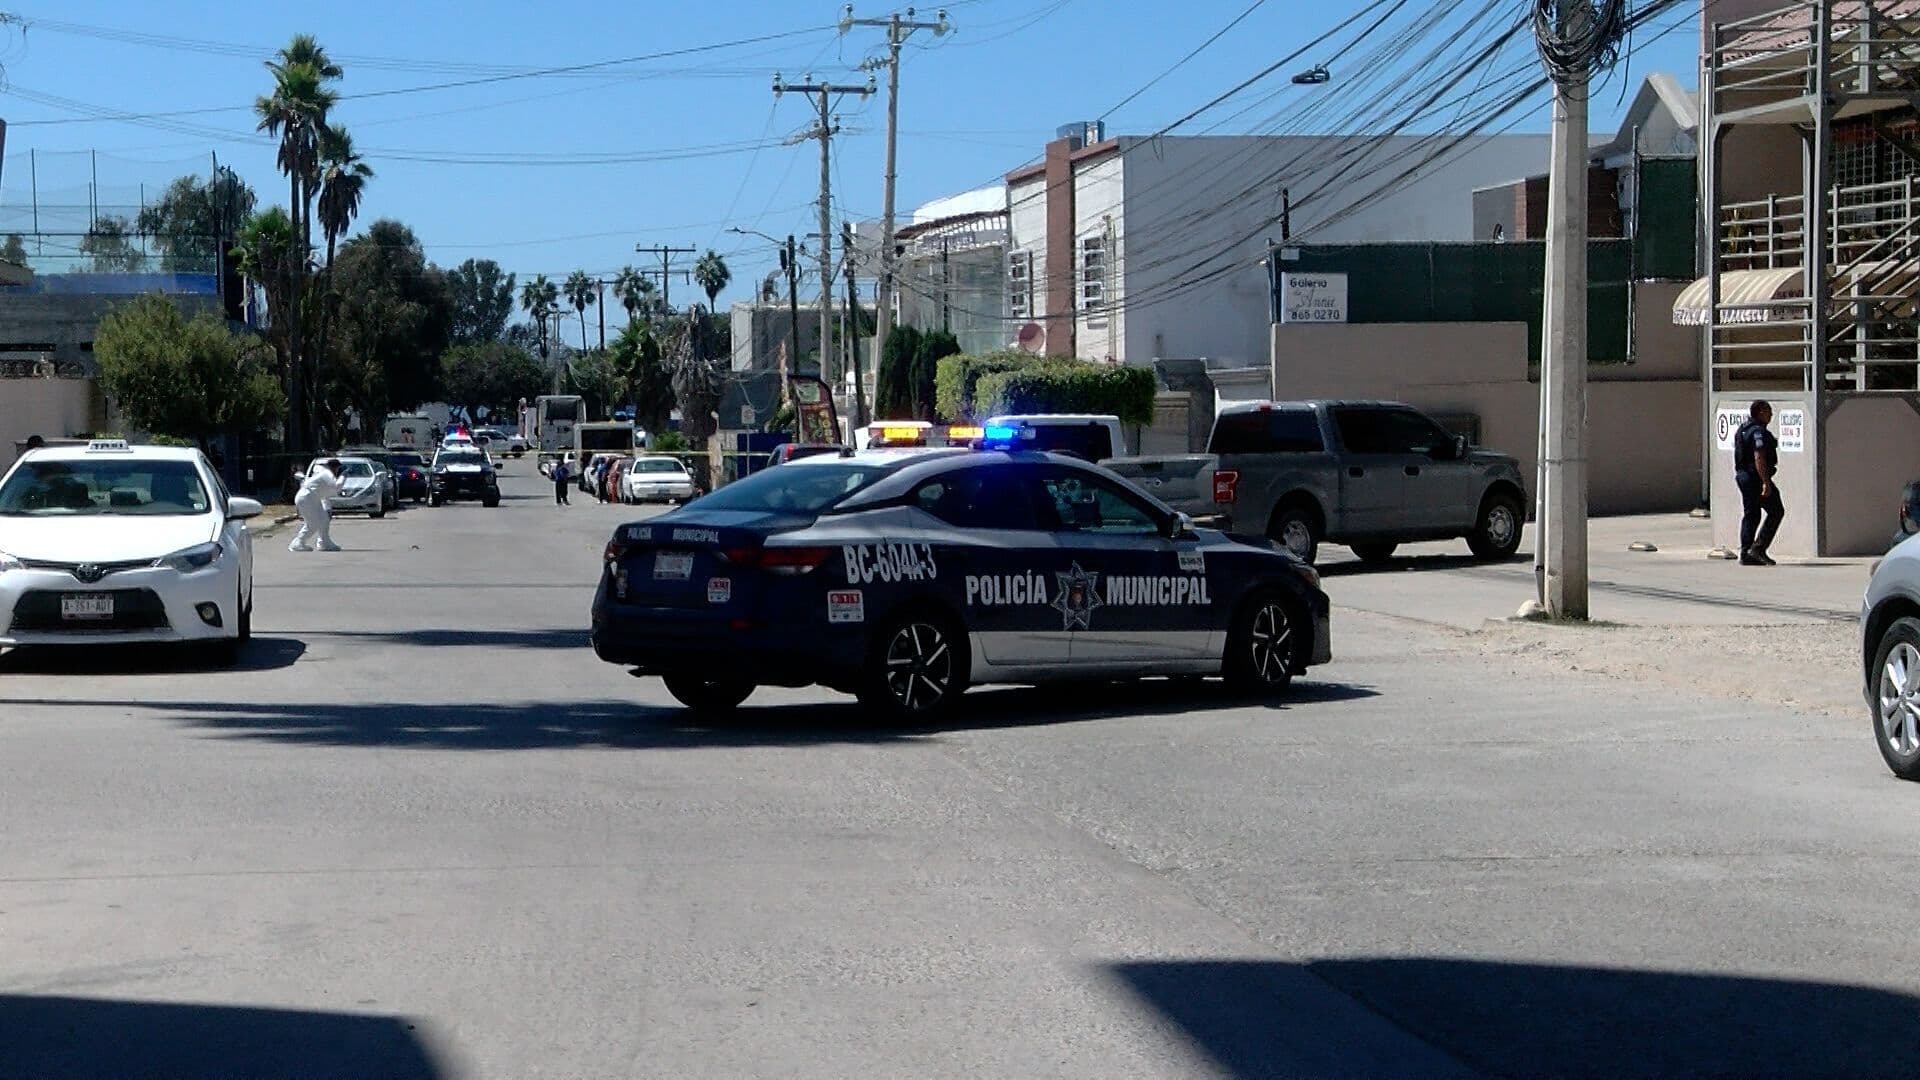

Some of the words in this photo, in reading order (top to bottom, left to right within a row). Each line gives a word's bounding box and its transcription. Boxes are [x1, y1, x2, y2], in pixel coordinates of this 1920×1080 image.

[842, 543, 937, 584] BC-604A-3
[965, 569, 1048, 606] POLICÍA
[1106, 575, 1212, 606] MUNICIPAL
